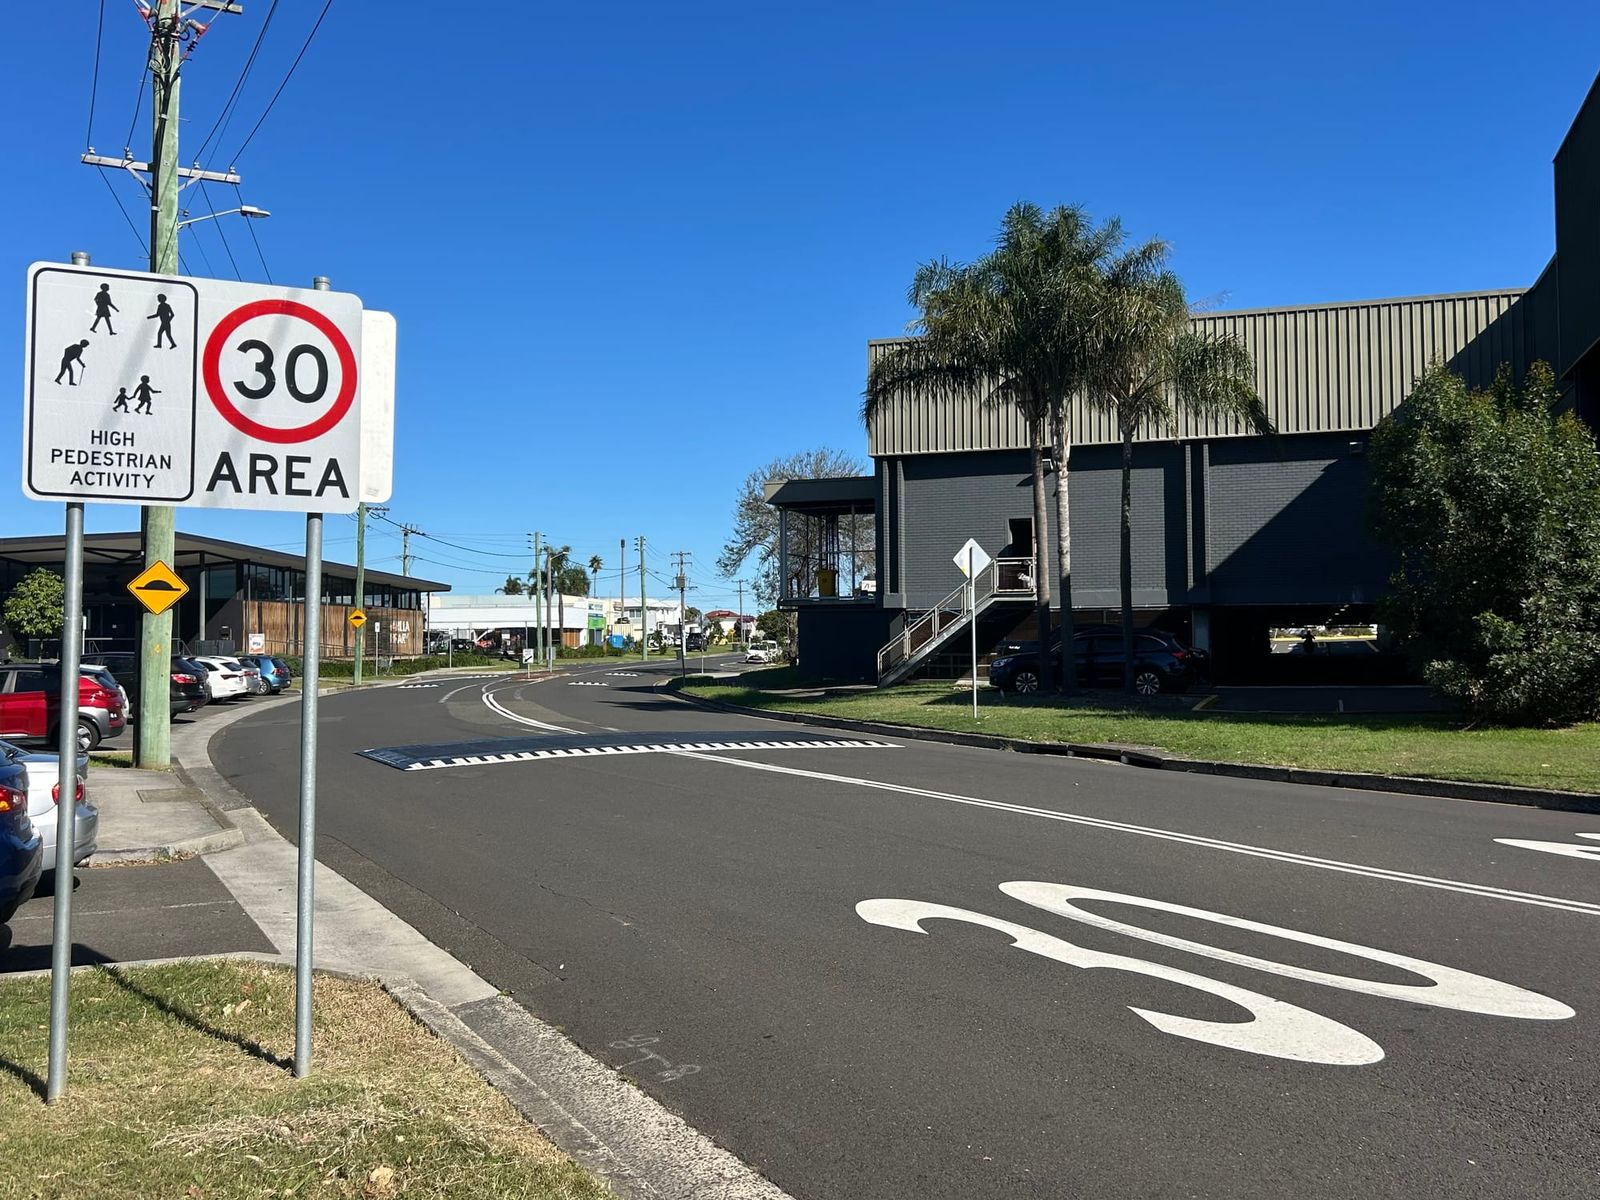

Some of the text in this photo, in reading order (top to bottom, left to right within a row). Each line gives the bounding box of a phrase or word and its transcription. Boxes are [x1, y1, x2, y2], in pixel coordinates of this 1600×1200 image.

[233, 339, 329, 404] 30
[91, 429, 135, 447] HIGH
[51, 448, 172, 470] PEDESTRIAN
[205, 451, 350, 499] AREA
[69, 470, 155, 489] ACTIVITY
[855, 880, 1577, 1066] 30
